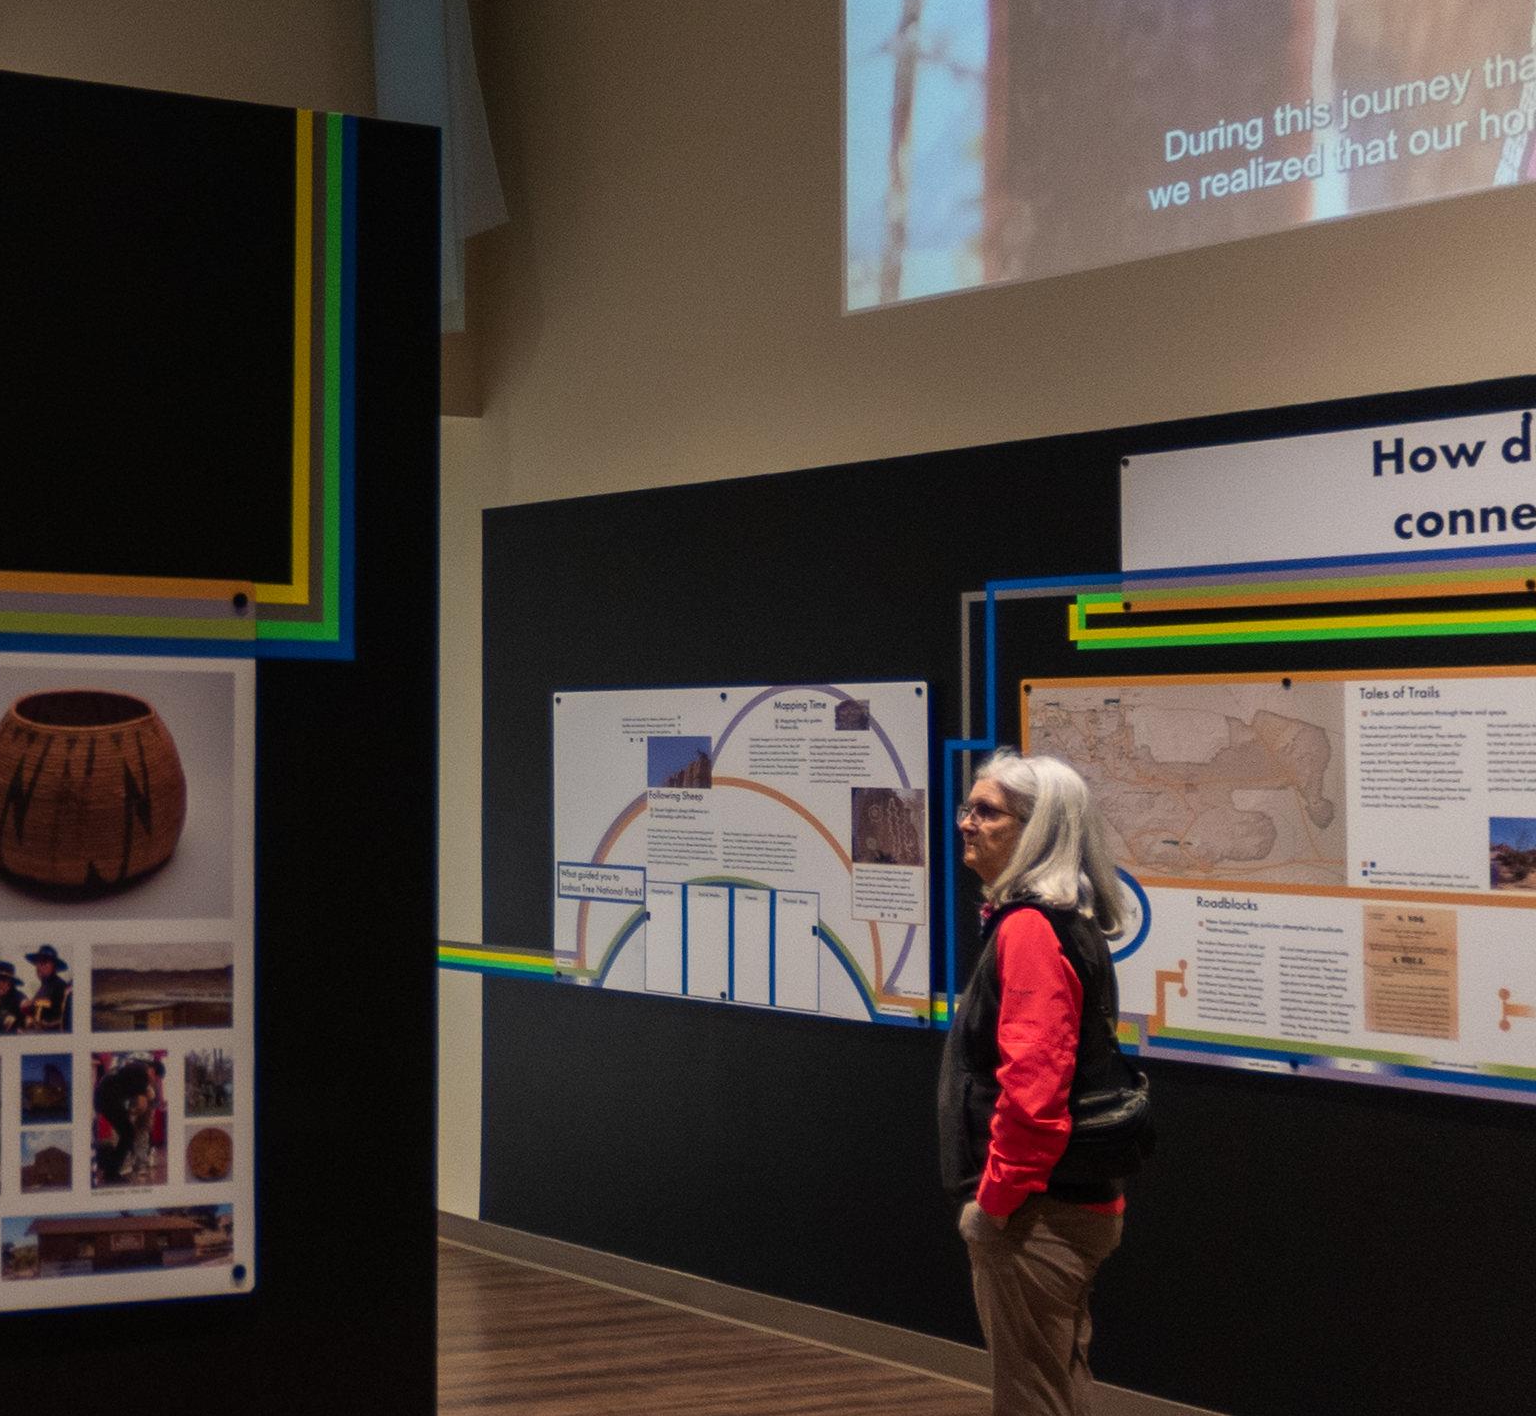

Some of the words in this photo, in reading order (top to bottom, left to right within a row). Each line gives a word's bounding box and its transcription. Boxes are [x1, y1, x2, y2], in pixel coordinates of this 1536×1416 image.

[1165, 118, 1264, 162] During
[1274, 99, 1331, 136] this
[1341, 68, 1472, 130] journey
[1147, 180, 1190, 210] we
[1200, 144, 1323, 199] realized
[1336, 130, 1398, 170] that
[1409, 120, 1468, 154] our
[1372, 437, 1486, 476] How
[1359, 687, 1389, 699] Tales
[1392, 685, 1405, 698] of
[1408, 685, 1440, 698] Trails
[773, 701, 807, 712] Mapping
[808, 699, 826, 709] Time
[648, 789, 681, 802] Following
[681, 790, 703, 801] Sheep
[1196, 896, 1258, 911] Roadblocks
